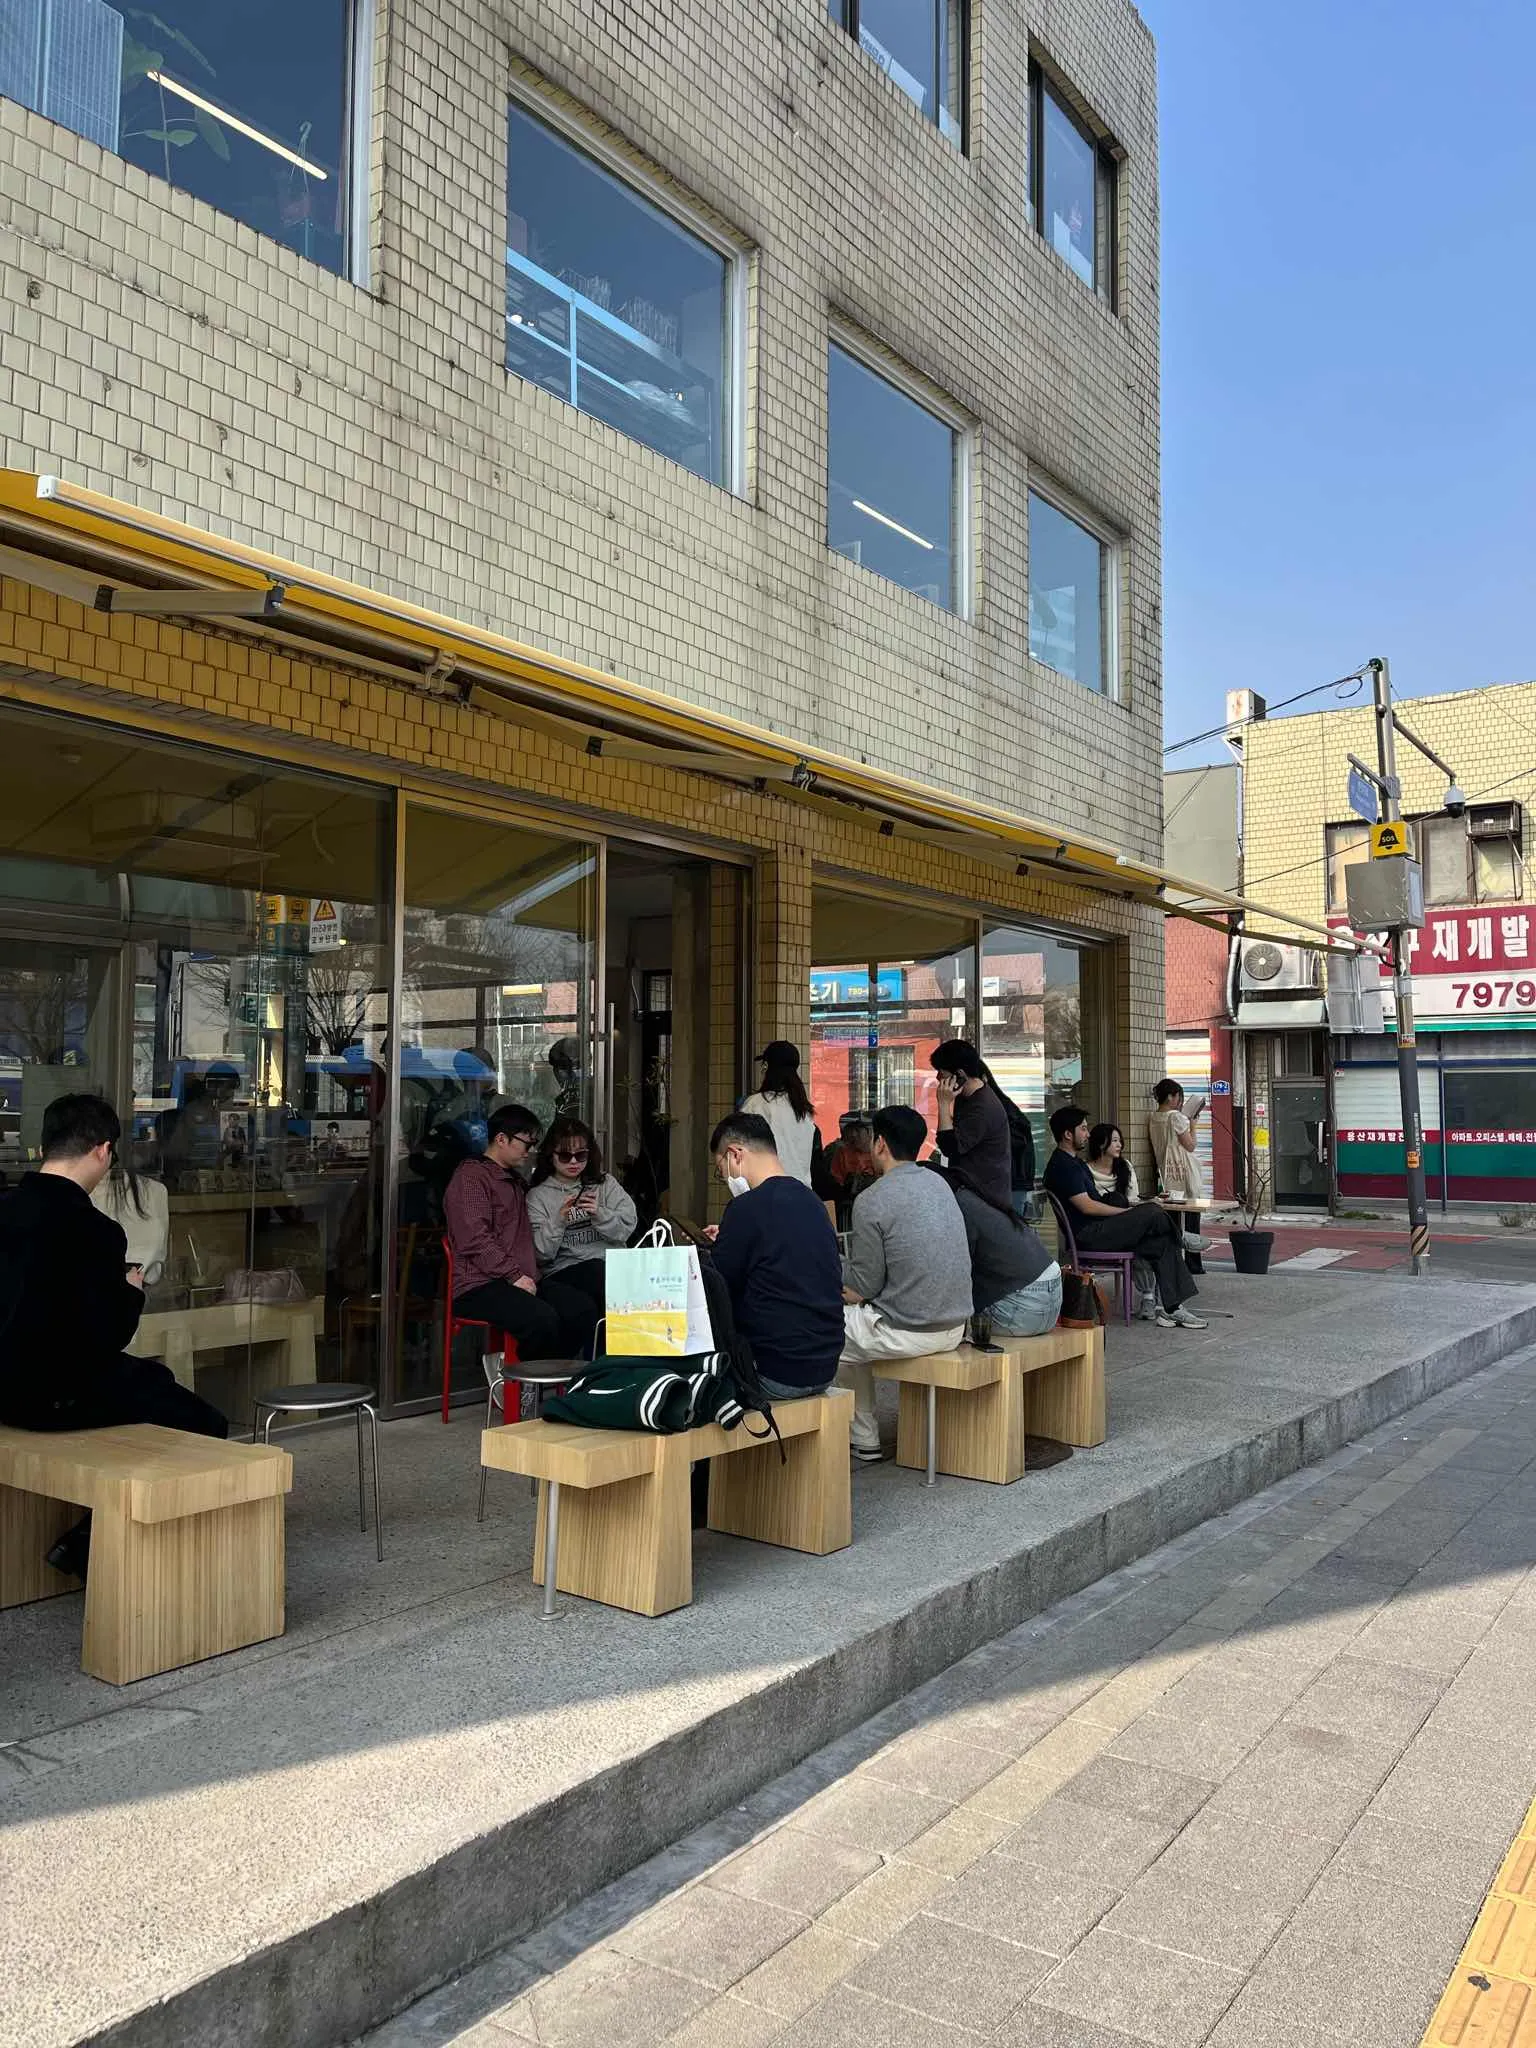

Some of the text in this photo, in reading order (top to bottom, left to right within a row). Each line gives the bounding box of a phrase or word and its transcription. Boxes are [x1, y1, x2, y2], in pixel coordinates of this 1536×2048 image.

[1382, 835, 1395, 843] SOS
[1432, 915, 1530, 962] 재개발
[1452, 981, 1536, 1009] 7979
